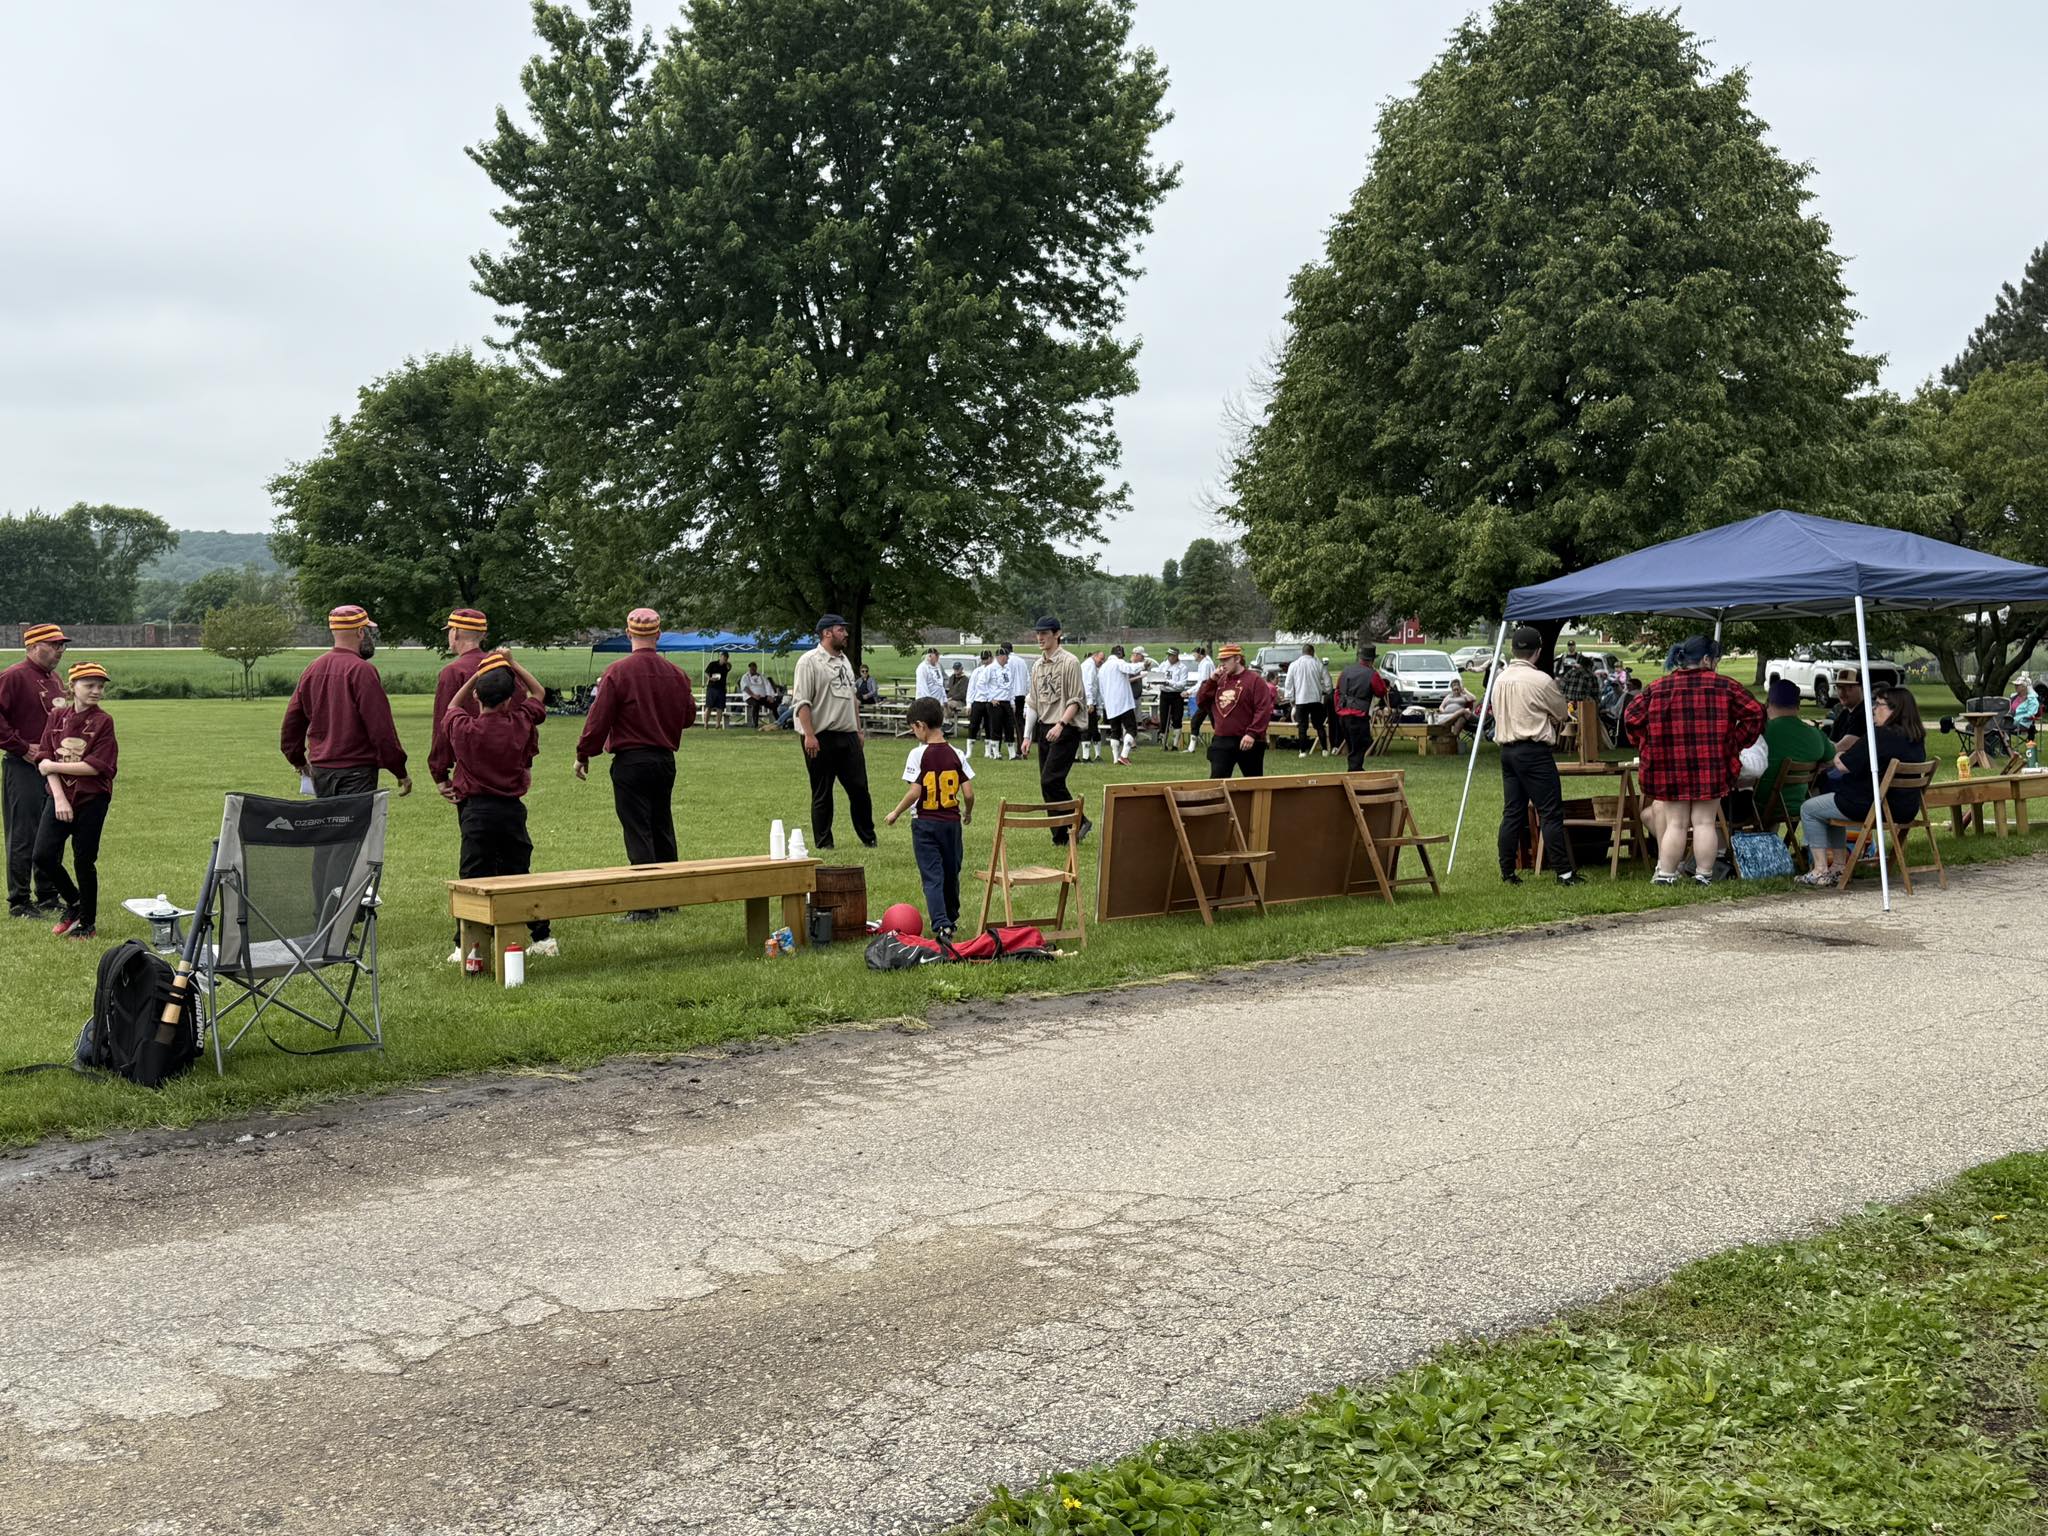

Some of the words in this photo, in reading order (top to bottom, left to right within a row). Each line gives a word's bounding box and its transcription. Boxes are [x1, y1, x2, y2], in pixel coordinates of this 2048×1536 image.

[2025, 749, 2032, 758] G
[923, 770, 959, 810] 18
[294, 819, 326, 827] OZARK
